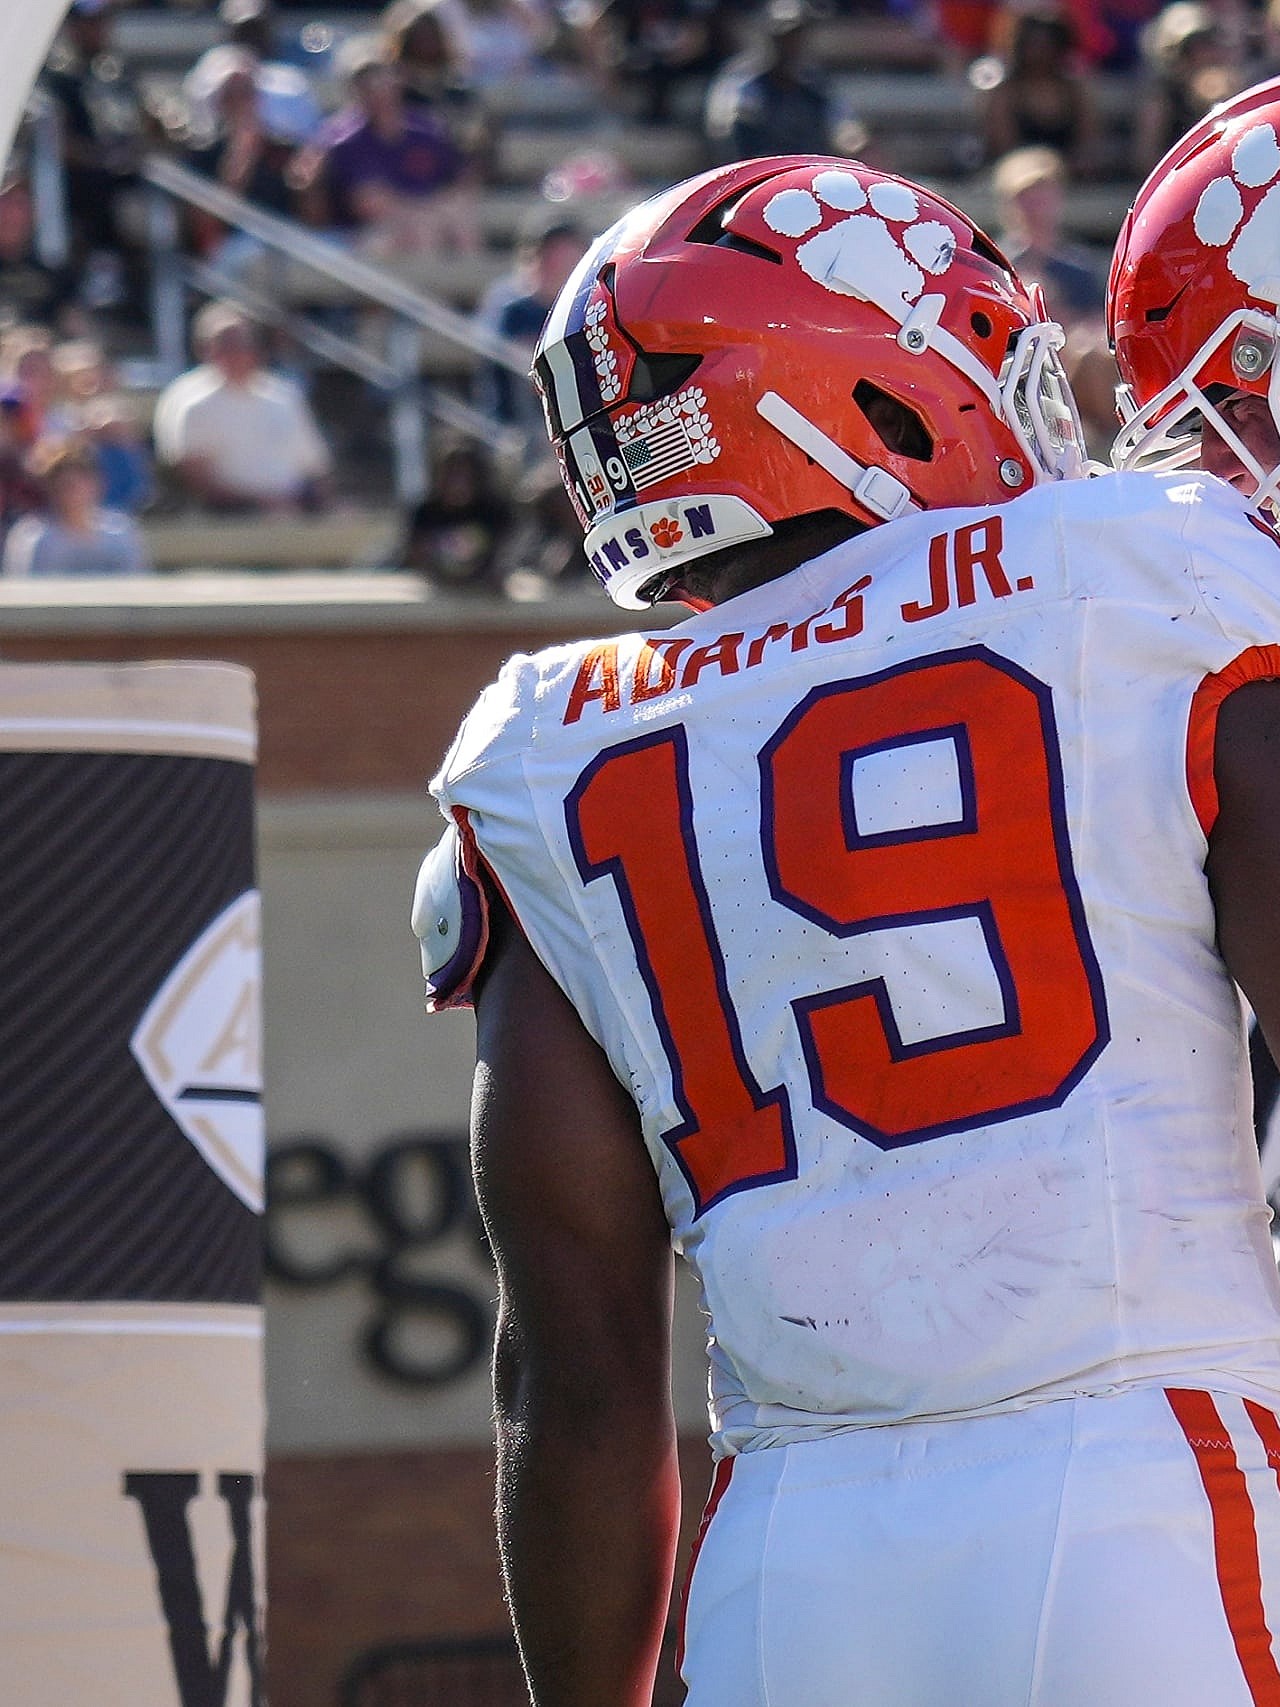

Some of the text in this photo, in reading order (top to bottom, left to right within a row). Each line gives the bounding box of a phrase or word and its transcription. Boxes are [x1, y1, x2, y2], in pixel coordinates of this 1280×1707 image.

[563, 515, 1035, 725] ADAMS JR.
[563, 643, 1110, 1222] 19
